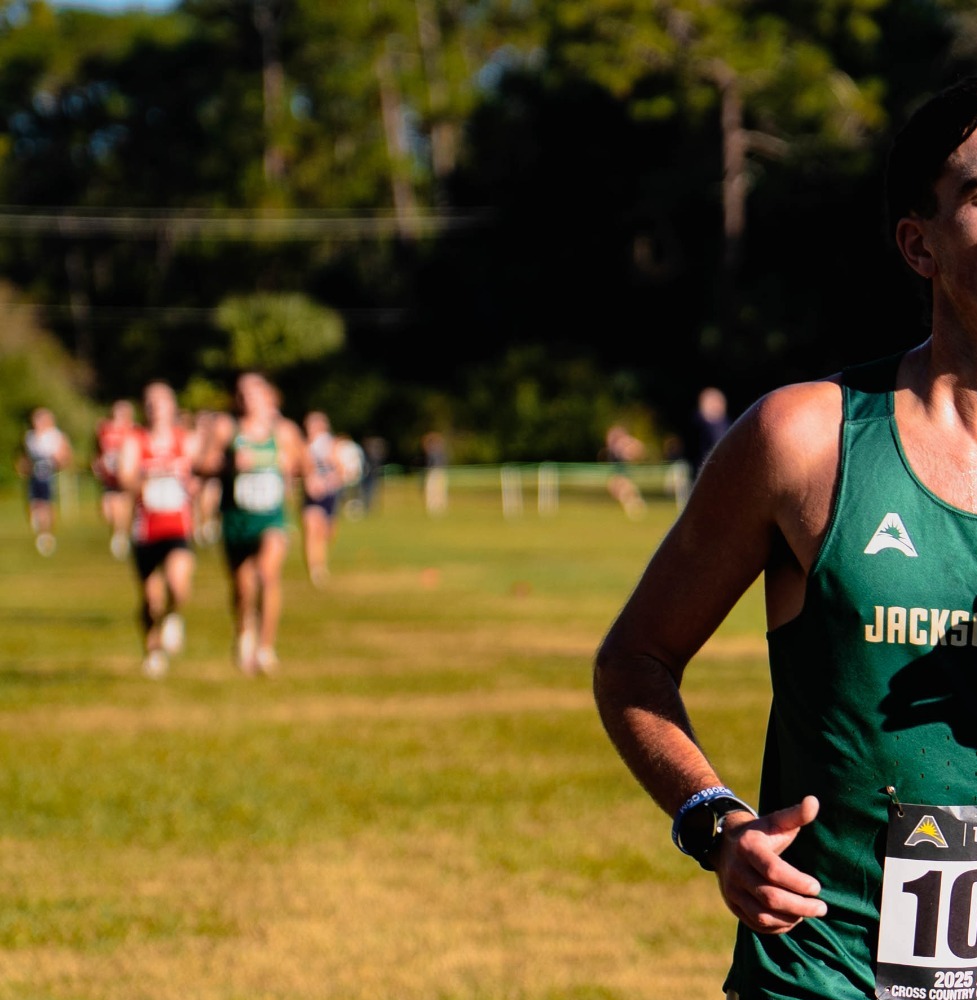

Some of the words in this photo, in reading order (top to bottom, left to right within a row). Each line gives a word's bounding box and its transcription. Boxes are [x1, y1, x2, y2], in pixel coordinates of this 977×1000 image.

[934, 970, 974, 989] 2025
[891, 985, 927, 999] CROSS
[929, 987, 975, 1000] COUNTRY
